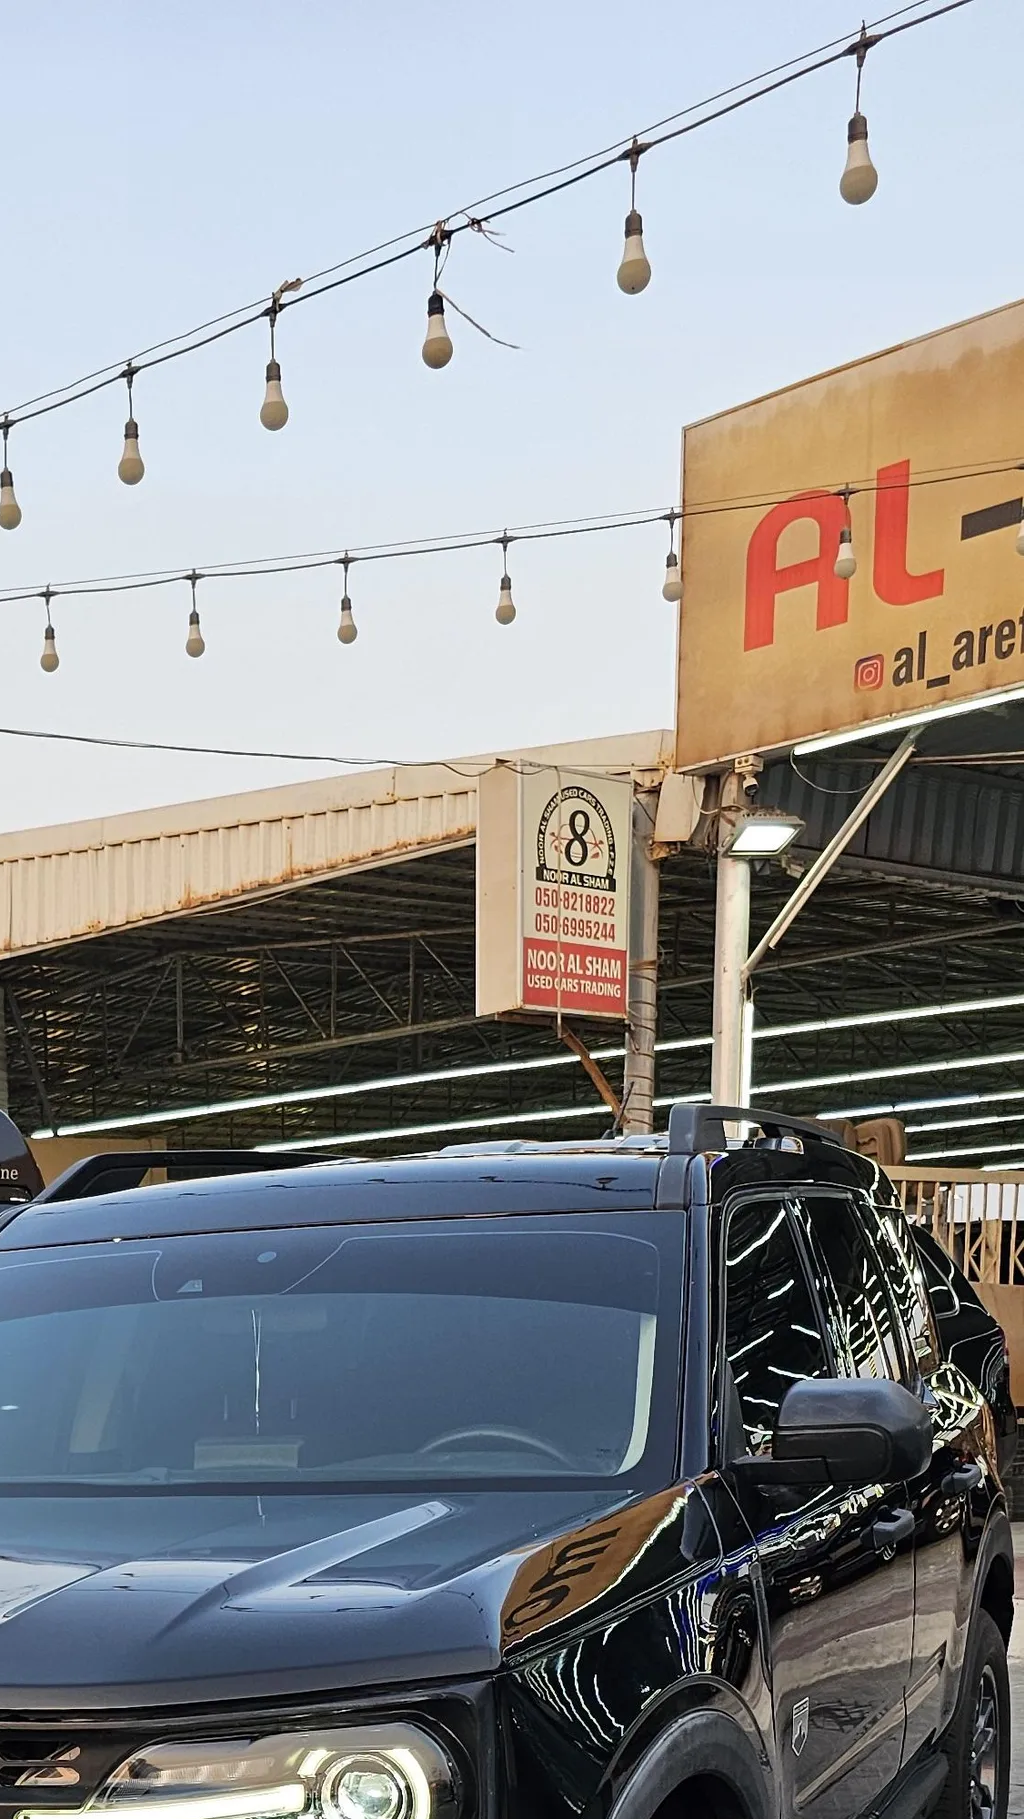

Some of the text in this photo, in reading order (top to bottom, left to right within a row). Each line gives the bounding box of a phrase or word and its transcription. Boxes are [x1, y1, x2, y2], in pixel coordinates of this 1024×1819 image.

[539, 818, 548, 833] AL
[578, 790, 596, 807] CARS
[595, 803, 613, 845] TRADING
[564, 809, 590, 867] 8
[543, 868, 609, 890] NOR AL SHAM
[535, 887, 616, 917] 050-8218822
[527, 948, 622, 980] NOOR AL SHAM
[527, 974, 621, 998] USED CARS TRADING
